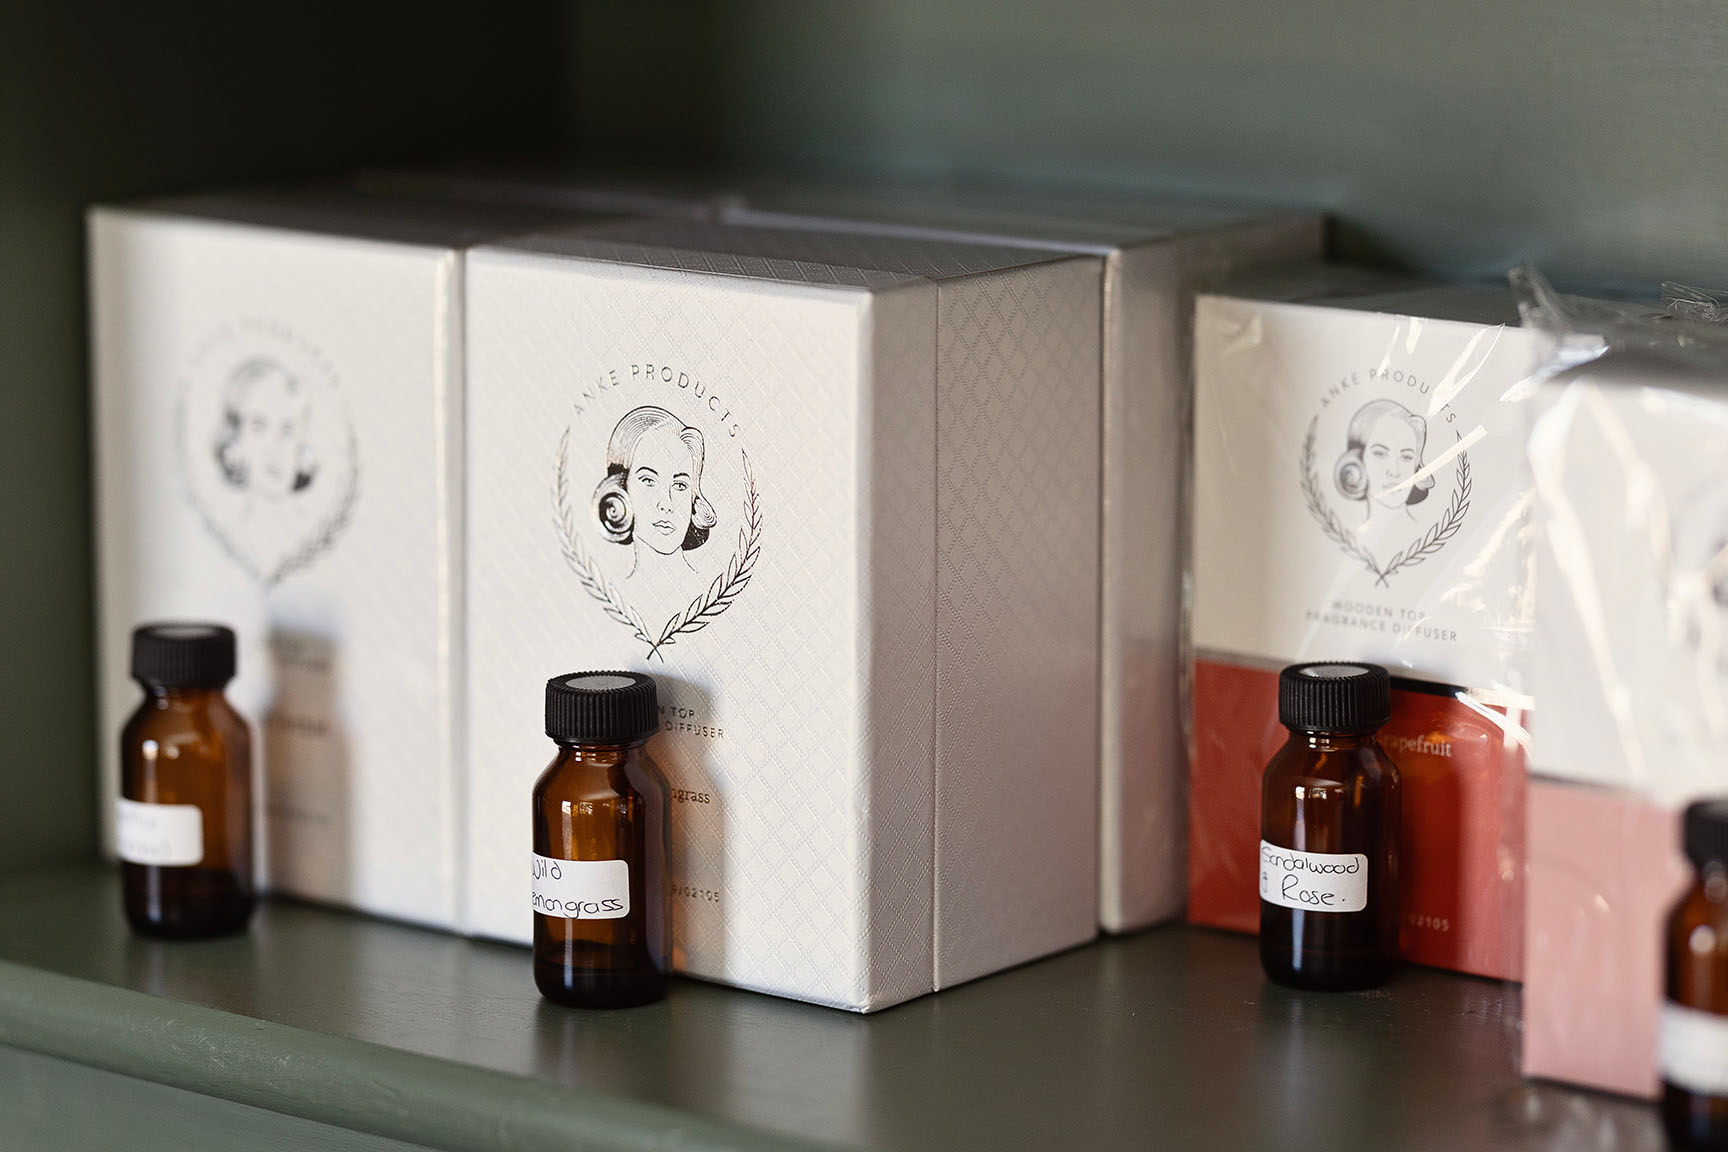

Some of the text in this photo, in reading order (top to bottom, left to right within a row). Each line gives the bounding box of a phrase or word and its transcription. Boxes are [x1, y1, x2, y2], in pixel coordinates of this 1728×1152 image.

[573, 363, 741, 438] ANKE PRODUCTS
[1369, 368, 1457, 424] PRODUTS
[1332, 601, 1425, 621] WOODEN TOP
[671, 705, 695, 719] TOP
[665, 720, 724, 738] DIFFUSER
[671, 788, 710, 803] ngrass
[1261, 846, 1360, 874] Sandalwood
[532, 891, 624, 919] emongrass
